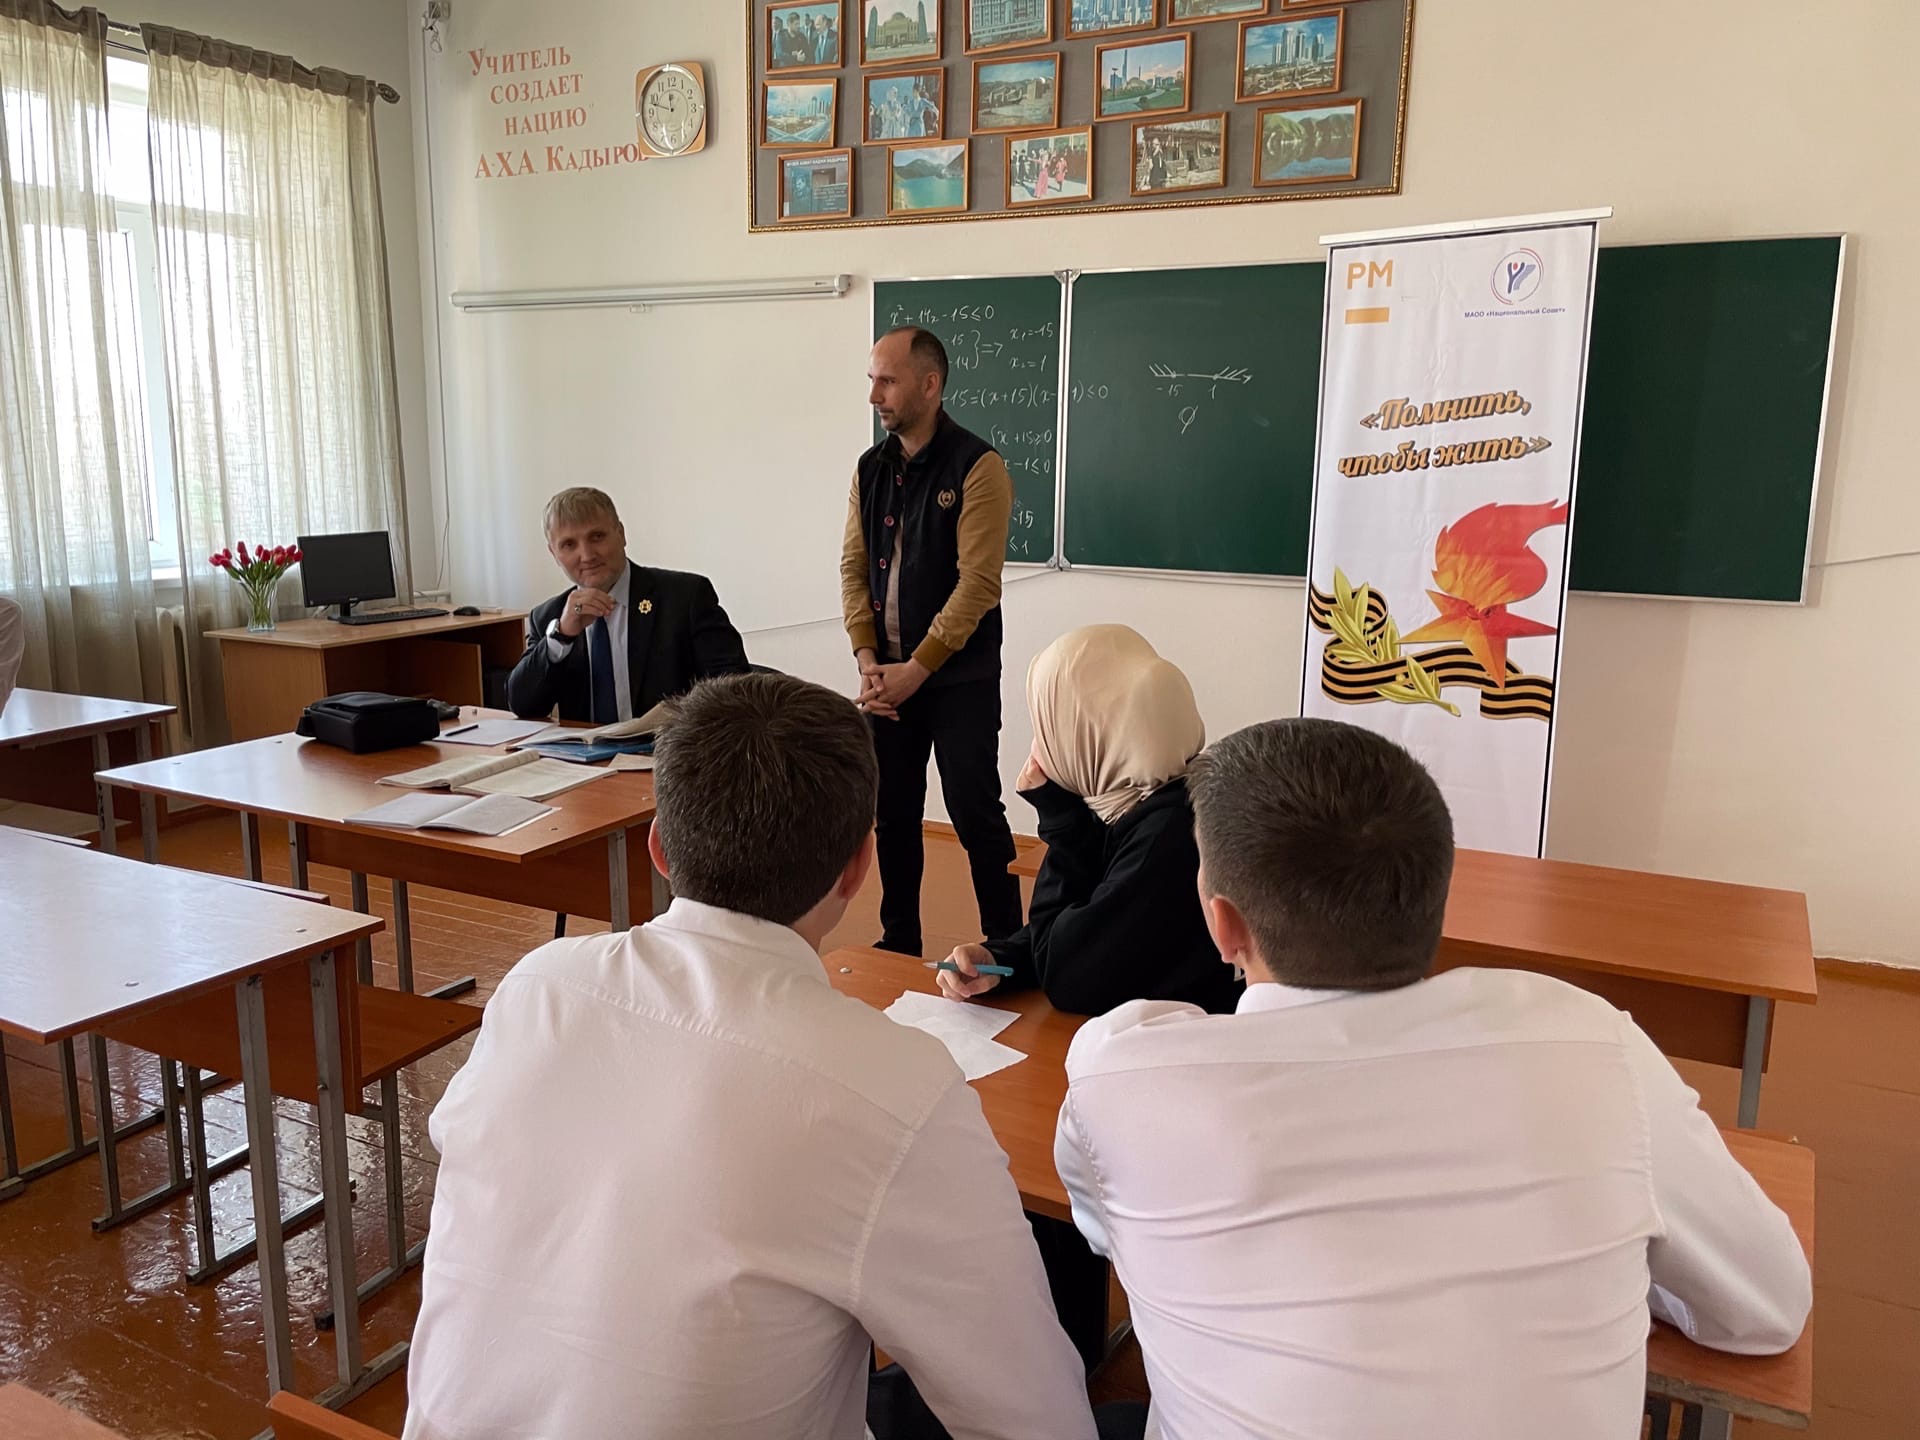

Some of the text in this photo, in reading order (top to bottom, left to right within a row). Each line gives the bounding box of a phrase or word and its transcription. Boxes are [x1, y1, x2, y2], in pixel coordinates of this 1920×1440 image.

[667, 76, 677, 88] 12
[650, 92, 659, 105] 10
[686, 88, 693, 100] 2
[648, 107, 655, 118] 9
[690, 102, 697, 113] 3
[1346, 259, 1394, 290] РМ
[1359, 390, 1532, 431] «Помнить,
[1337, 436, 1553, 478] чтобы жить»
